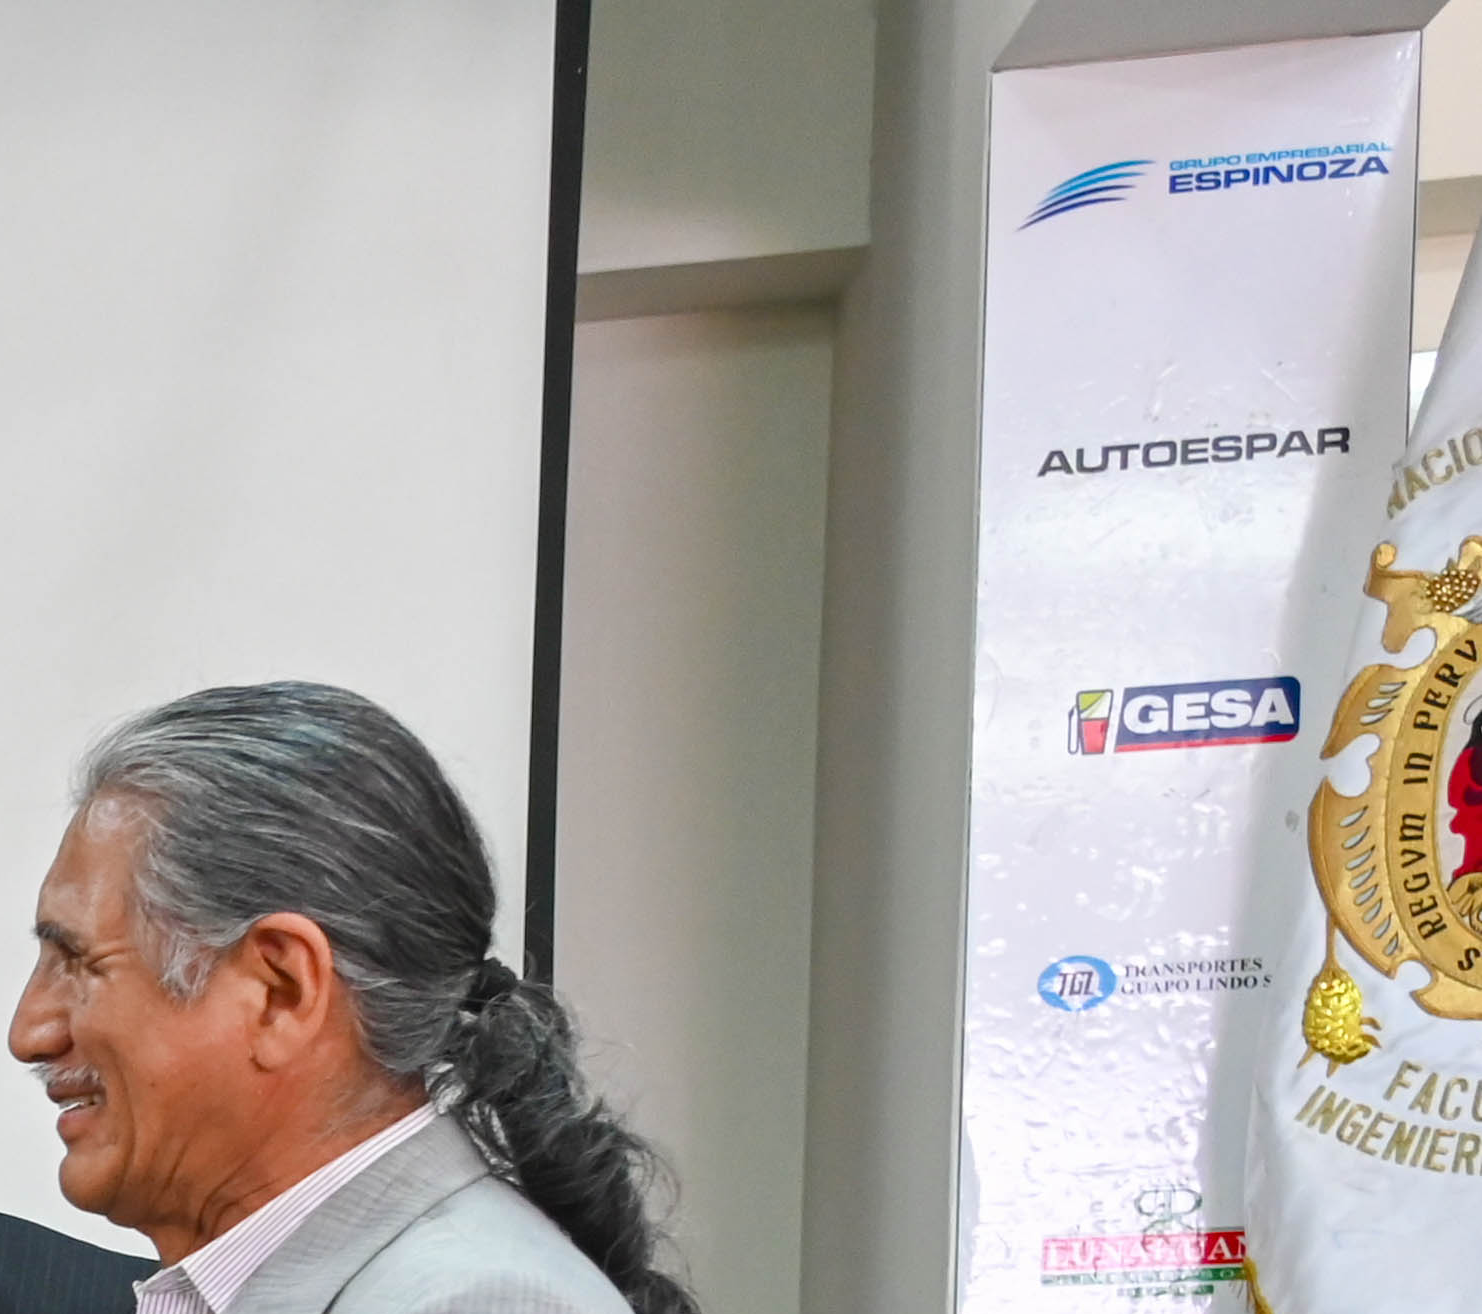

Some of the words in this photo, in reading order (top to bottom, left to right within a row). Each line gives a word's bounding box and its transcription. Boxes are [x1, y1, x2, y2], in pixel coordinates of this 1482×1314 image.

[1168, 156, 1390, 195] ESPINOZA
[1169, 154, 1242, 171] GRUPO
[1245, 142, 1392, 164] EMPRESARIAL
[1036, 426, 1351, 478] AUTOESPAR
[1122, 686, 1296, 737] GESA
[1124, 957, 1263, 979] TRANSPORTES
[1196, 975, 1255, 991] LINDO
[1294, 1084, 1482, 1177] INGENIER
